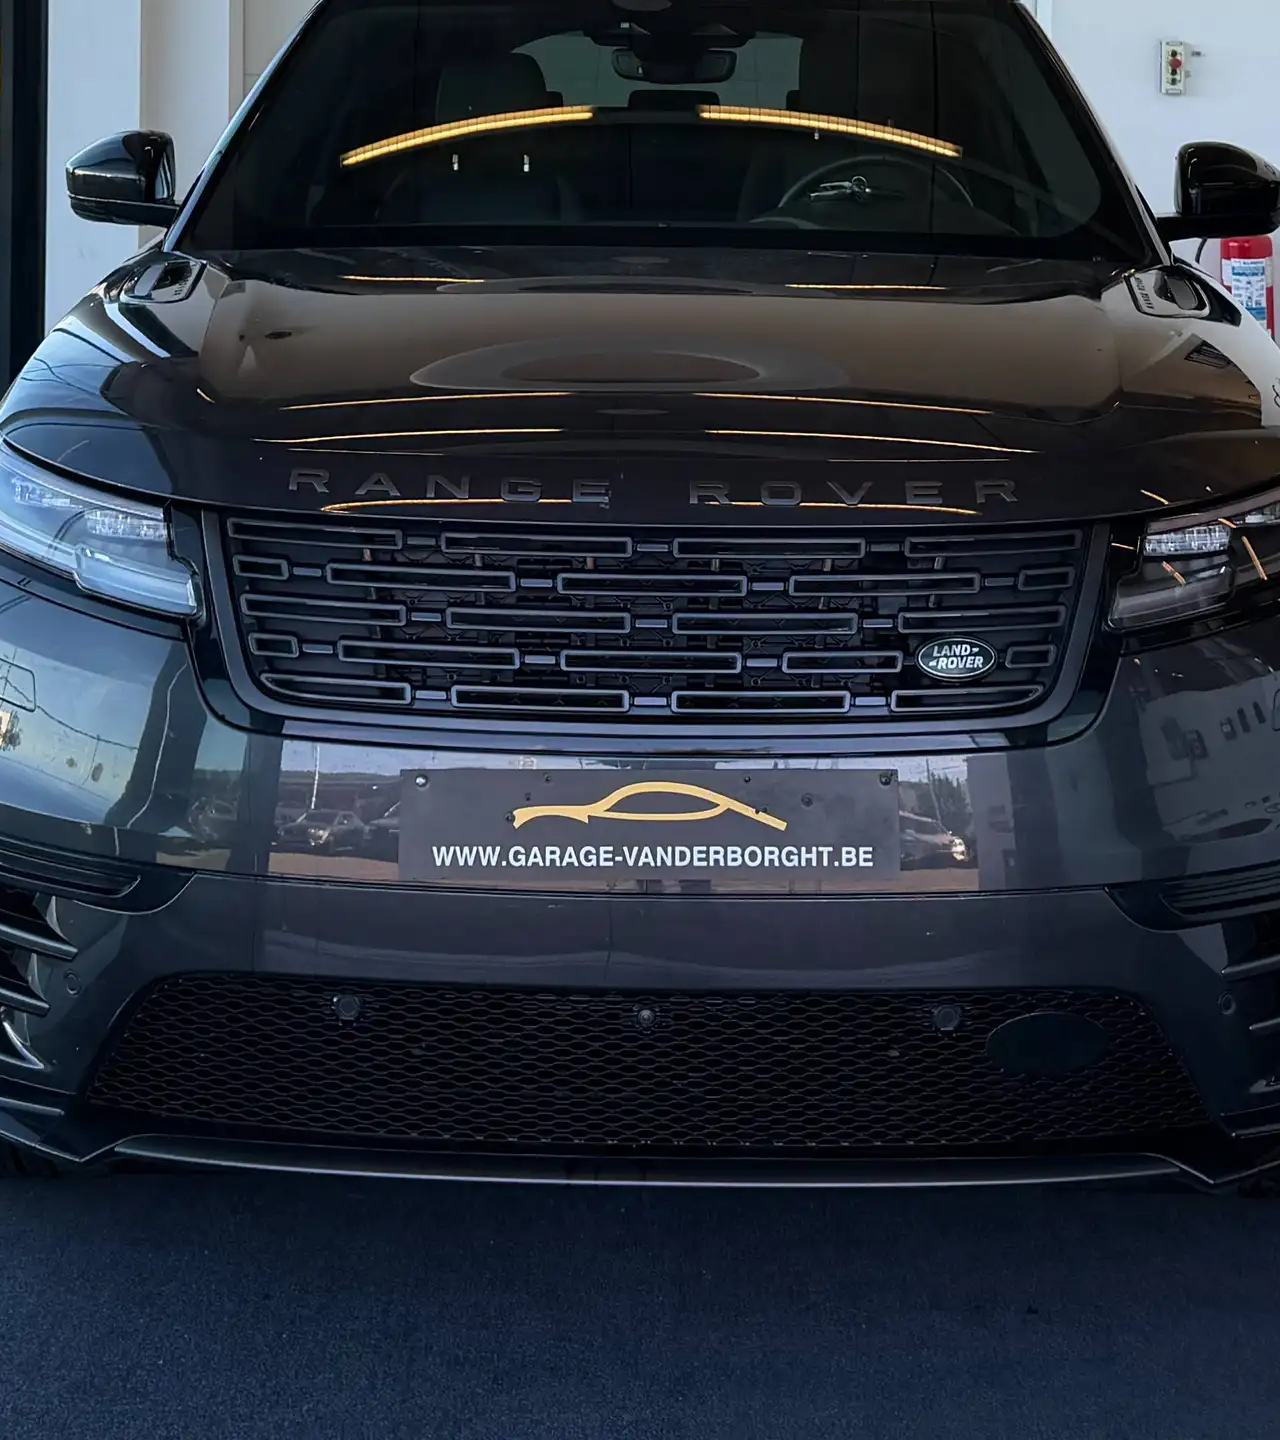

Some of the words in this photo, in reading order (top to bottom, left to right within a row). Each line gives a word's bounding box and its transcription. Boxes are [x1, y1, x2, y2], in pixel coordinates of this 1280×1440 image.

[288, 467, 611, 504] RANGE
[688, 478, 1019, 508] ROVER
[932, 643, 971, 658] LAND
[937, 655, 984, 670] ROVER
[431, 844, 874, 868] WWW.GARAGE-VANDERBORGHT.BE
